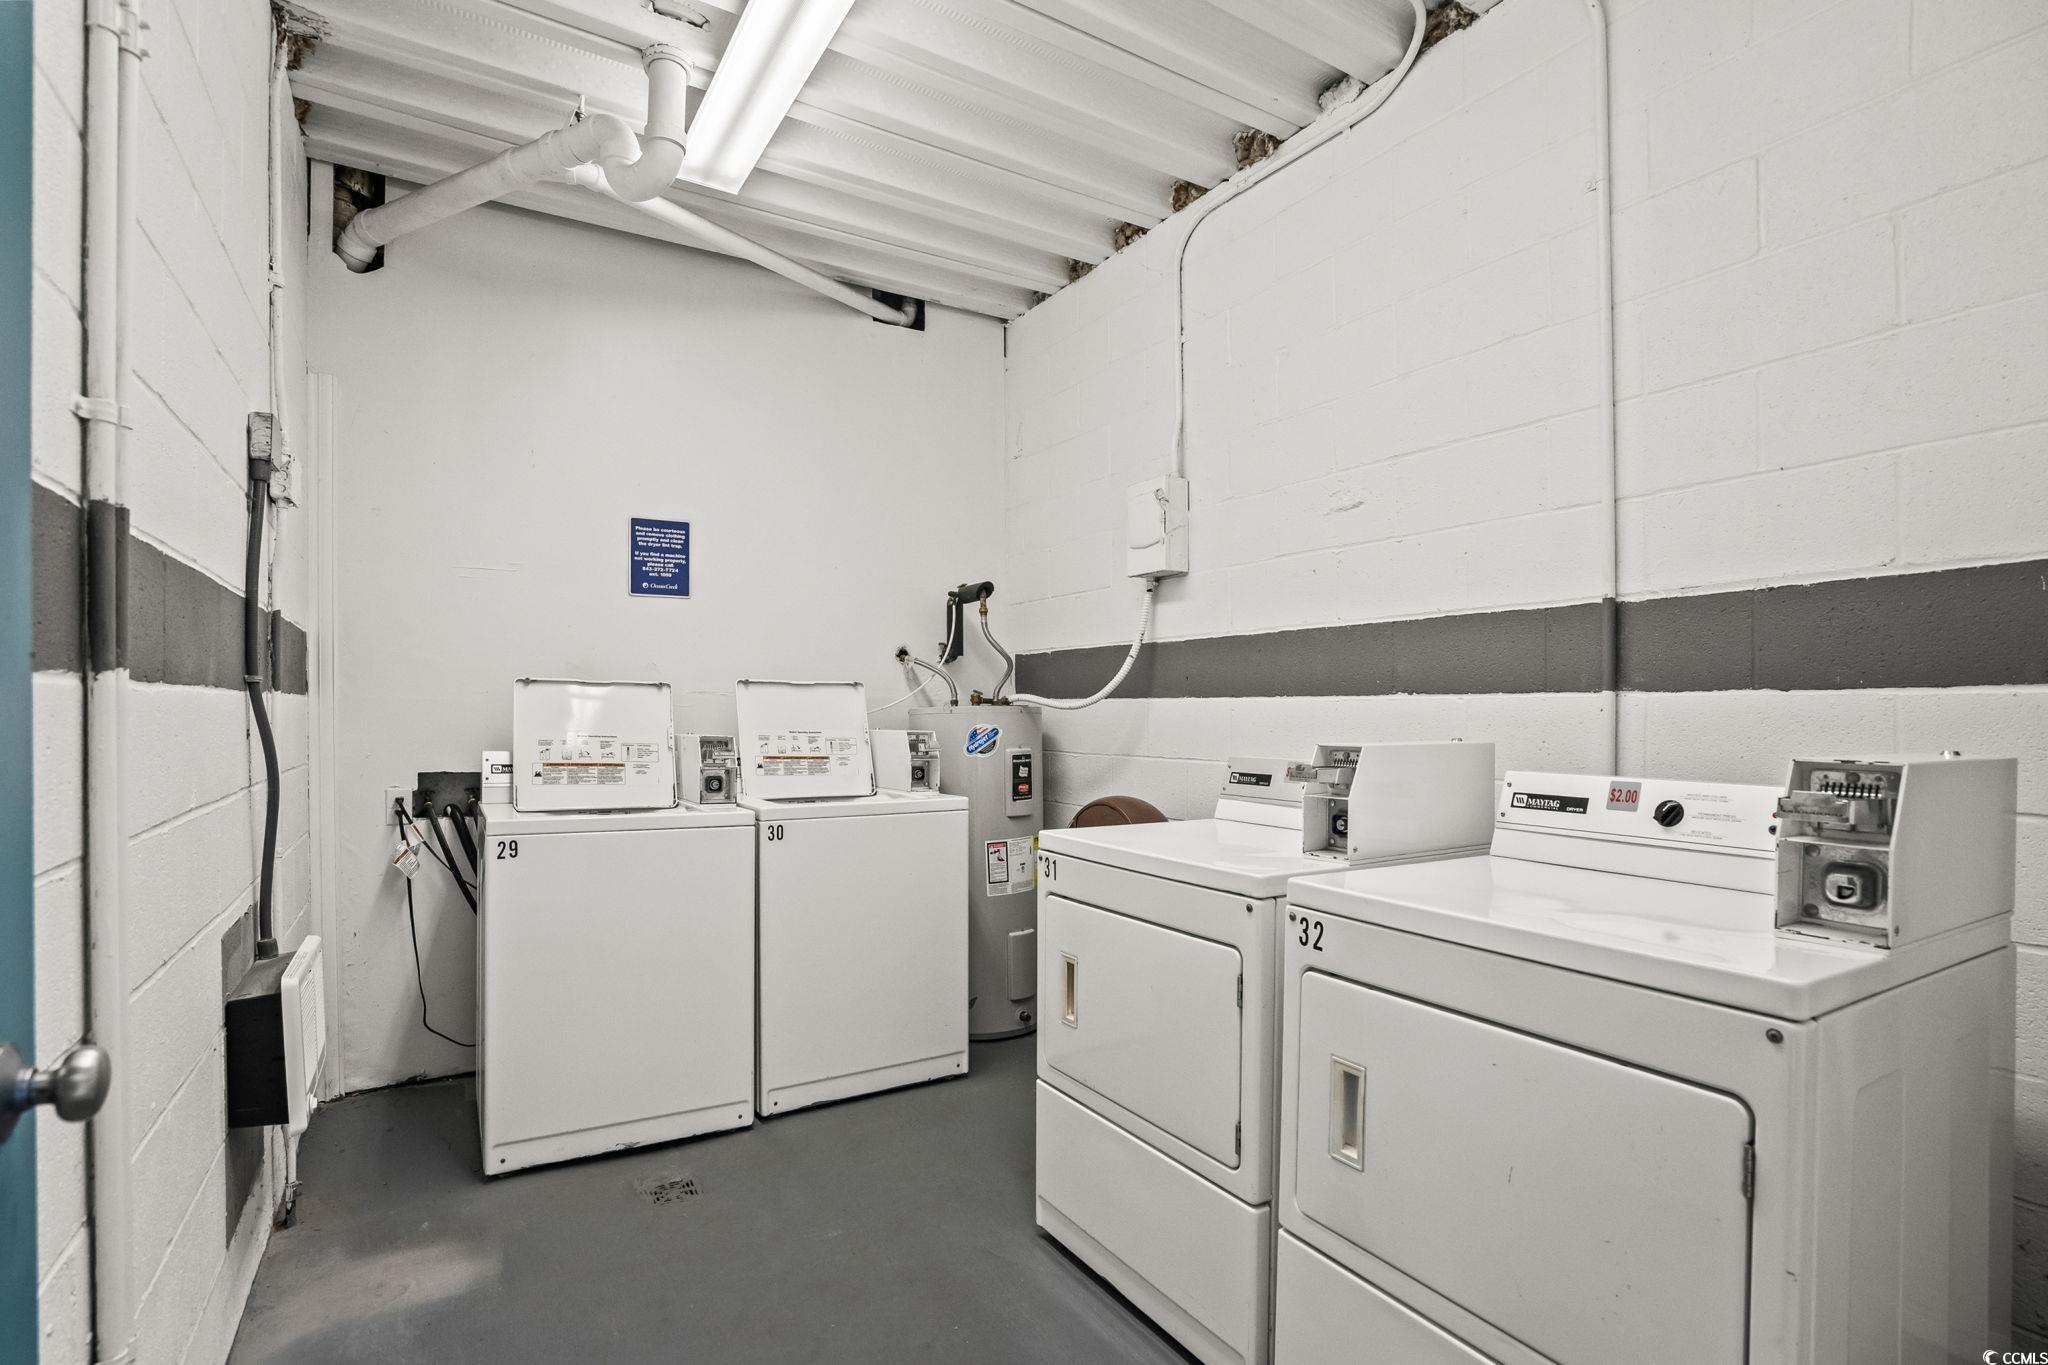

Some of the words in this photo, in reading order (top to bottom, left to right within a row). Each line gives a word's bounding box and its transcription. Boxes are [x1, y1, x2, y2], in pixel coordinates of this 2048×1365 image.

[1527, 798, 1560, 807] MAYTAG
[1609, 788, 1638, 804] $2.00
[767, 824, 784, 841] 30
[497, 840, 518, 859] 29
[1045, 857, 1056, 880] 31
[1299, 917, 1324, 952] 32
